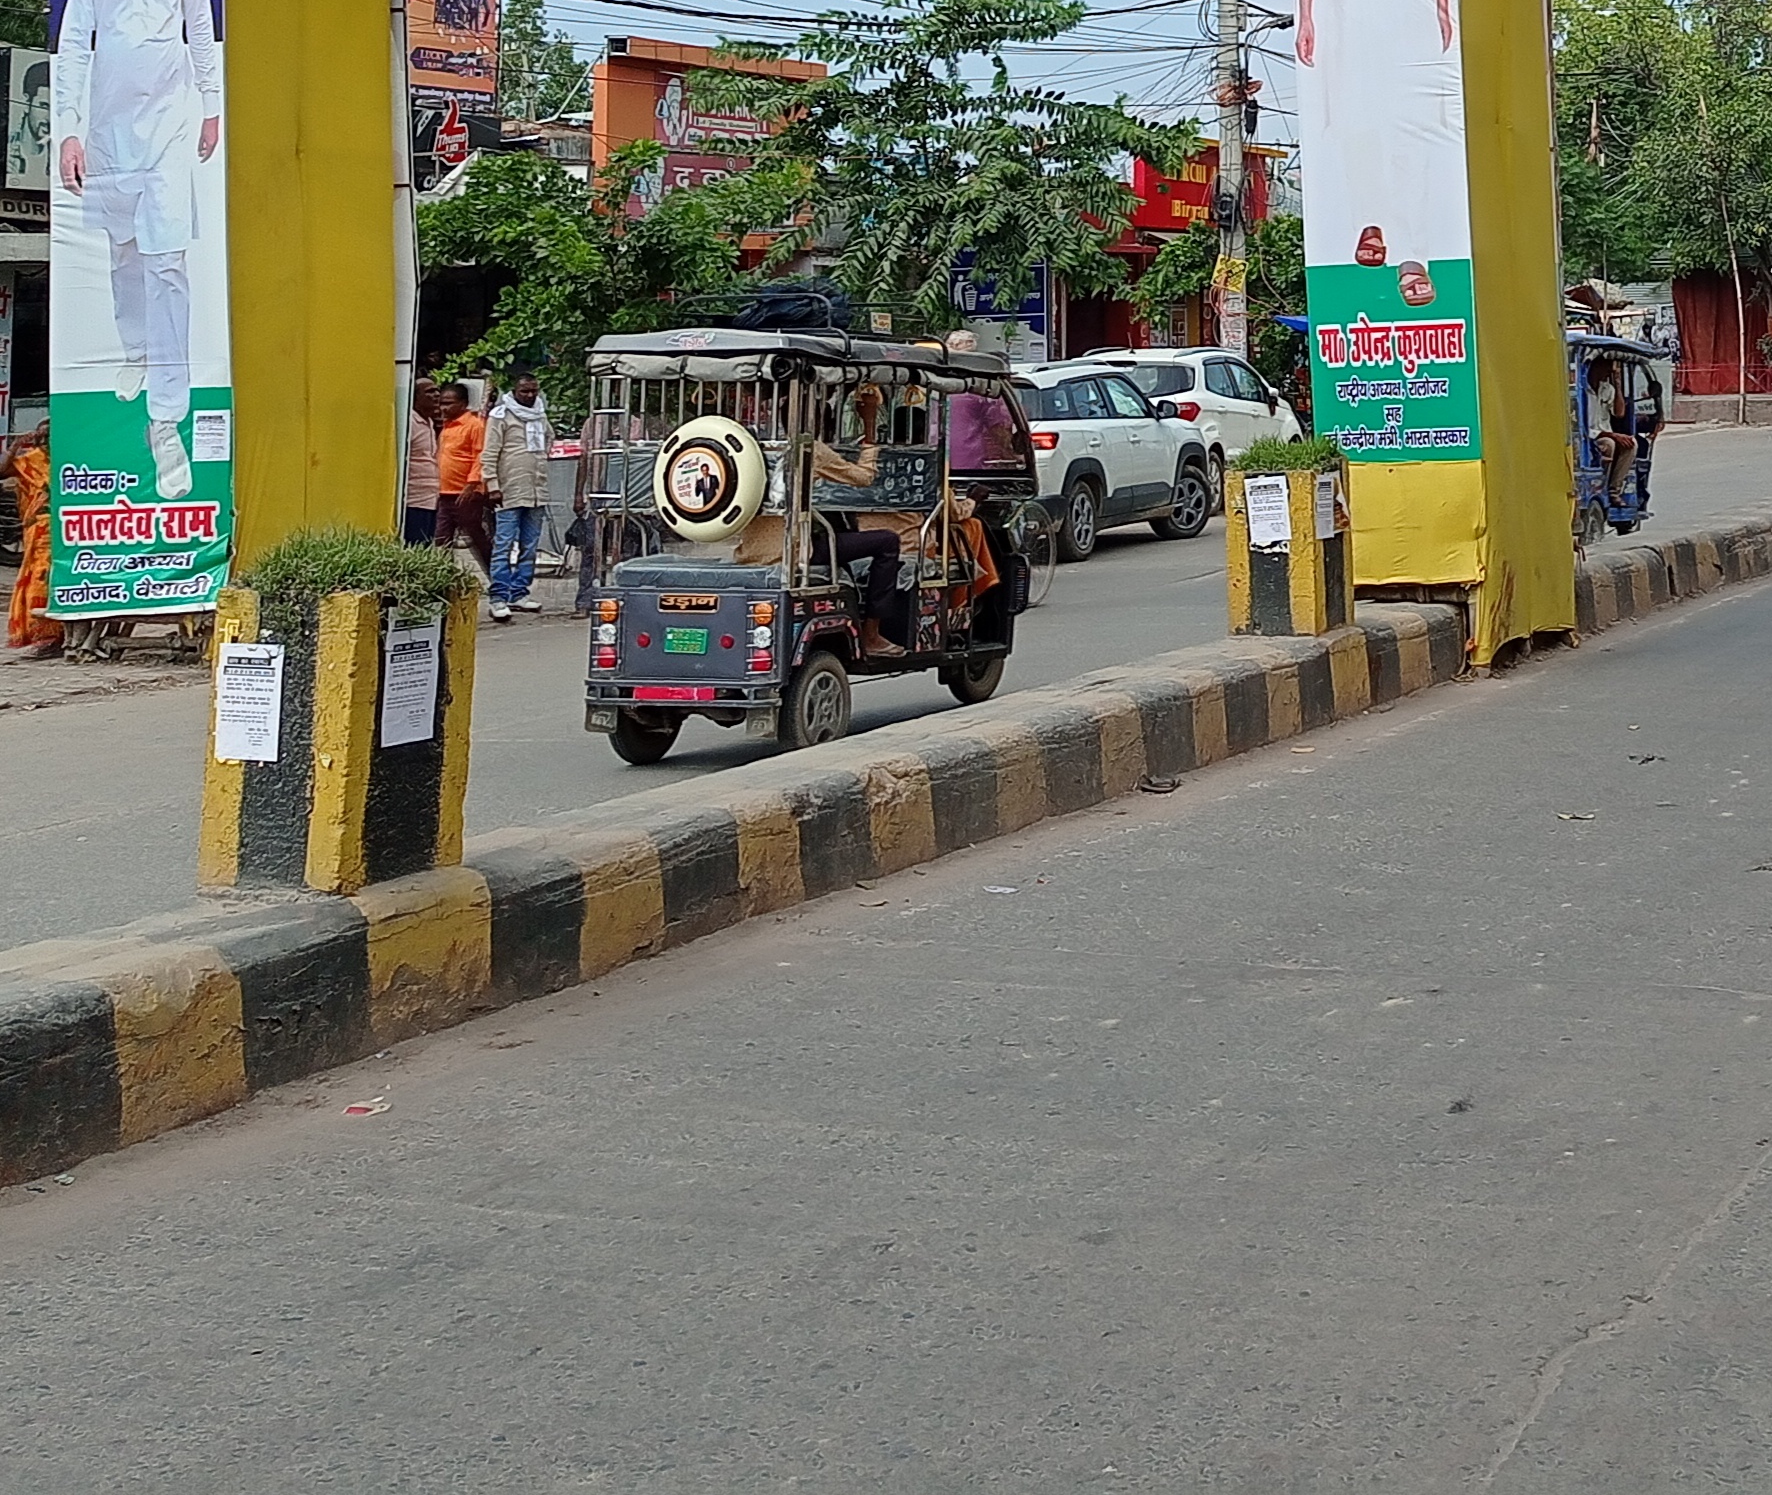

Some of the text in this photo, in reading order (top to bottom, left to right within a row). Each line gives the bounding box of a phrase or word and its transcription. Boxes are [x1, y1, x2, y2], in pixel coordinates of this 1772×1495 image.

[420, 49, 447, 60] LUCKY
[1350, 314, 1394, 365] उपेन्द्र
[1396, 321, 1466, 375] कुशवाहा
[1337, 376, 1448, 405] राष्ट्रीय अध्यक्ष, रालोजद
[1383, 404, 1403, 425] सह
[1340, 430, 1376, 454] केन्द्रीय
[1404, 429, 1432, 447] भारत
[1432, 428, 1470, 446] सरकार
[61, 467, 117, 494] निवेदक
[62, 502, 217, 544] लालदेव राम
[72, 549, 194, 574] जिला अध्यक्ष
[56, 574, 209, 606] रालोजद, वैशाली
[660, 596, 717, 610] उड़ान
